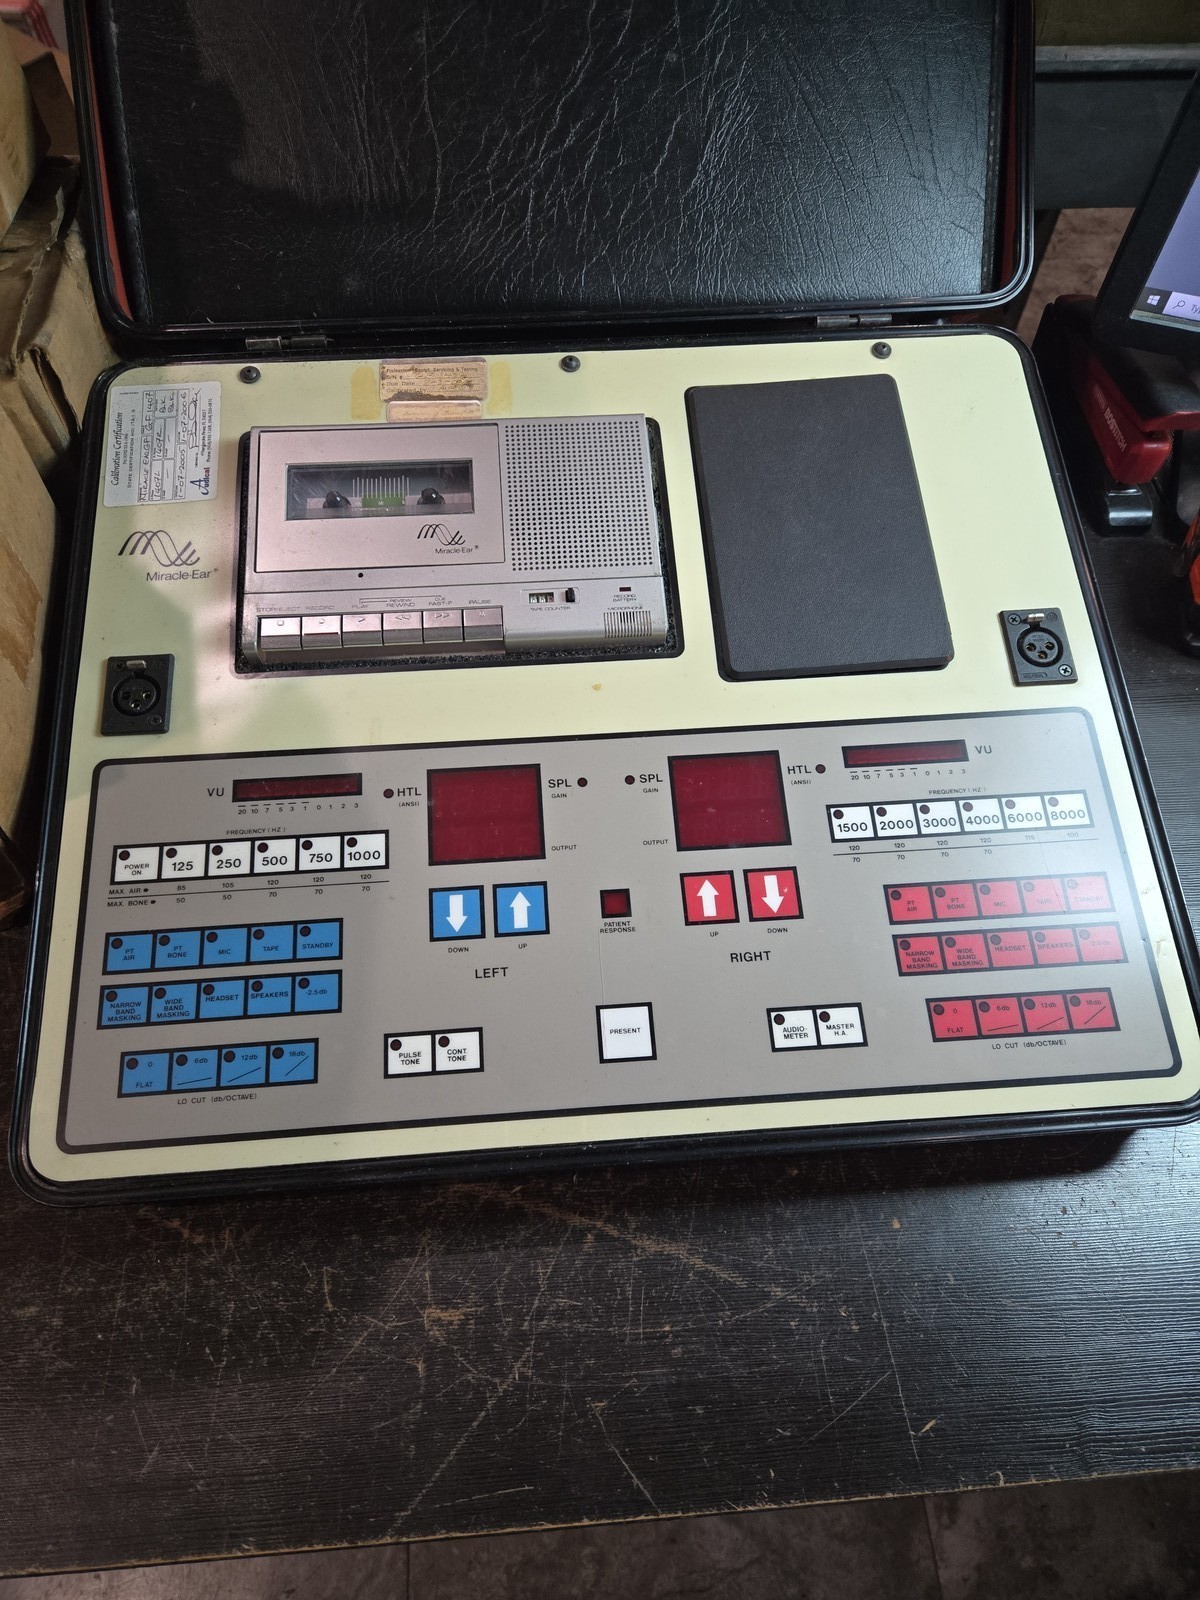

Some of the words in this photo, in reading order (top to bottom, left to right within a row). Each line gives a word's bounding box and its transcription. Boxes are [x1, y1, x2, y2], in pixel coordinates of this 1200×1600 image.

[113, 412, 124, 449] Certification
[1104, 406, 1127, 452] BOSTITCH
[110, 451, 120, 486] Calibration
[975, 745, 992, 754] VU
[787, 765, 812, 775] HTL
[640, 774, 663, 783] SPL
[548, 779, 572, 788] SPL
[207, 787, 225, 797] VU
[397, 787, 422, 797] HTL
[837, 822, 868, 833] 1500
[880, 820, 914, 831] 2000
[923, 817, 956, 828] 3000
[965, 815, 1000, 826] 4000
[1008, 812, 1042, 823] 6000
[1051, 809, 1086, 820] 8000
[172, 861, 193, 871] 125
[216, 859, 241, 869] 250
[262, 856, 287, 866] 500
[309, 853, 333, 863] 750
[347, 851, 380, 861] 1000
[302, 942, 334, 950] STANDBY
[994, 944, 1026, 952] HEADSET
[1037, 941, 1074, 950] SPEAKERS
[730, 951, 771, 963] RIGHT
[475, 967, 508, 978] LEFT
[206, 994, 239, 1002] HEADSET
[251, 991, 289, 999] SPEAKERS
[107, 1014, 141, 1022] MASKING
[610, 1027, 641, 1035] PRESENT
[1023, 1039, 1067, 1048] (db/OCTAVE)
[211, 1093, 257, 1102] (db/OCTAVE)
